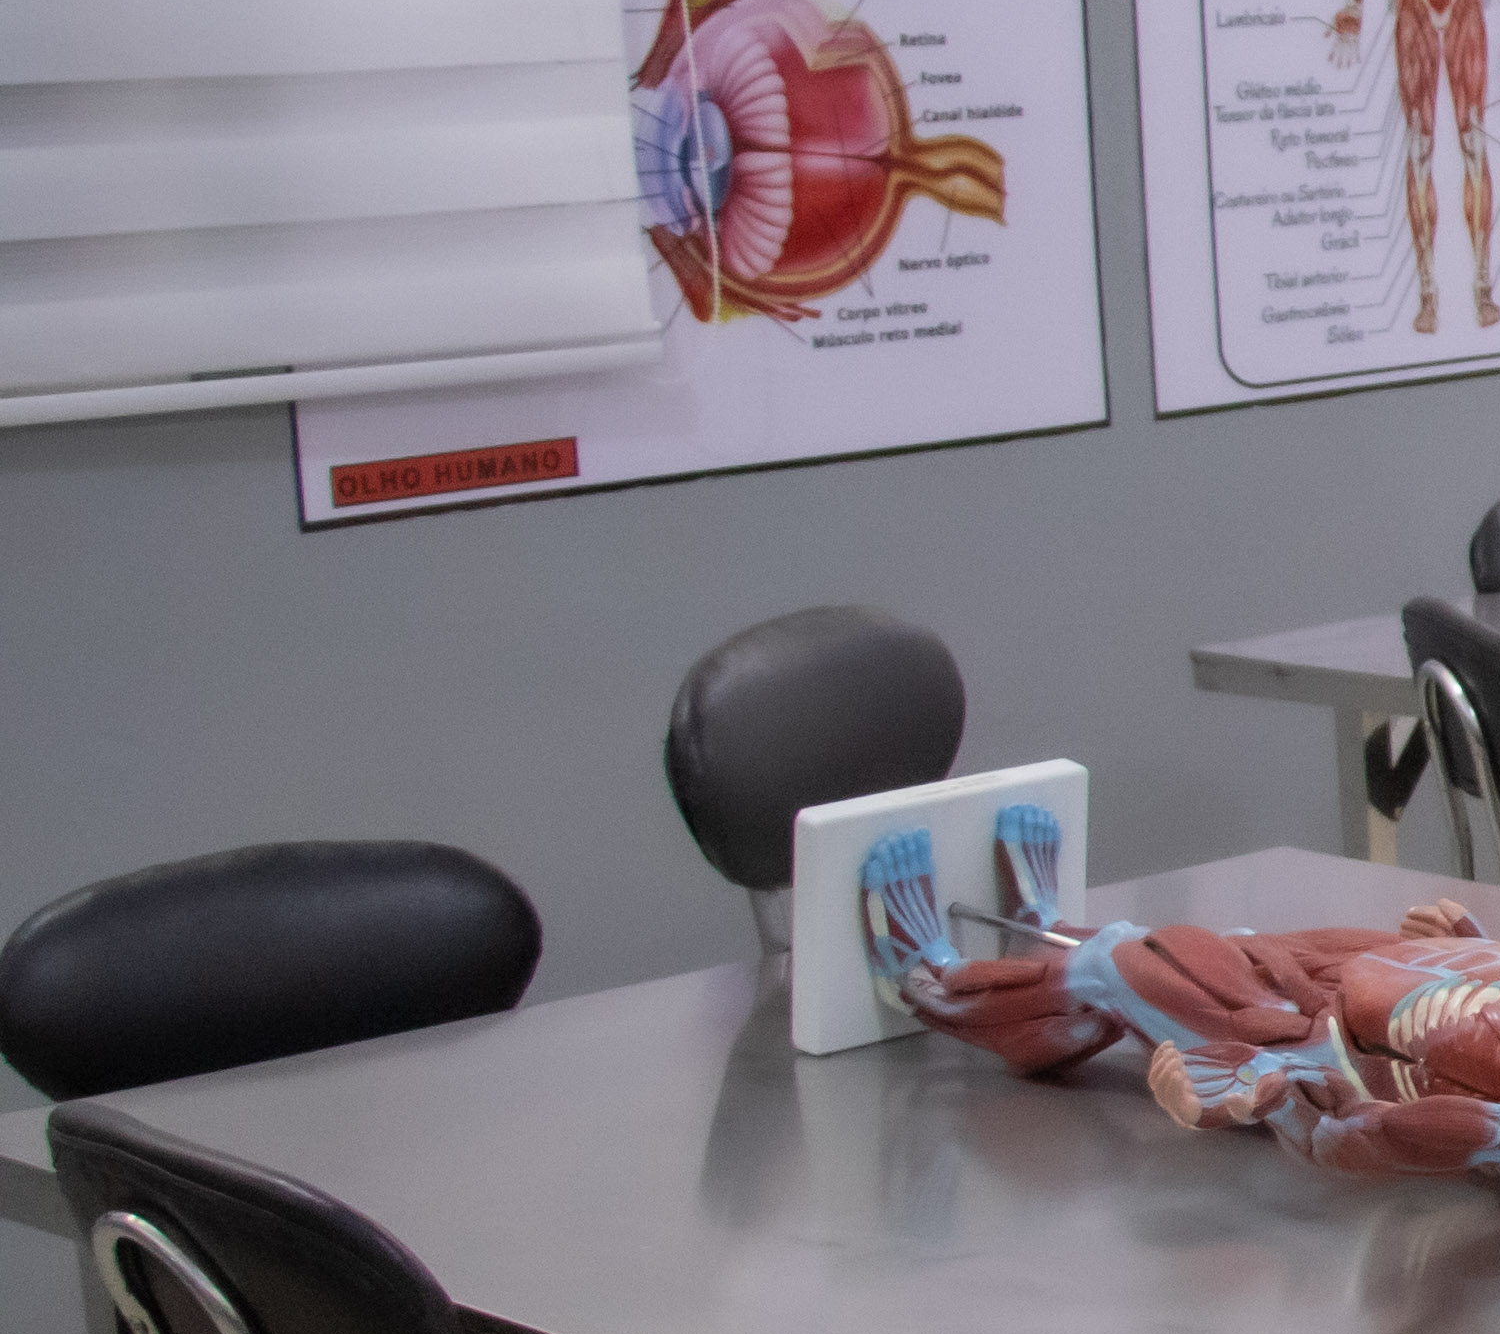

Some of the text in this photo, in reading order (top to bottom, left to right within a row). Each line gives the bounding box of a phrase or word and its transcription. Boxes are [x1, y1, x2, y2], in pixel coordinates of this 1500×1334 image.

[900, 32, 946, 46] Retina
[923, 107, 962, 122] Canal
[899, 258, 941, 271] Nervo
[838, 307, 880, 322] Corpo
[337, 448, 561, 498] OLHO HUMANO
